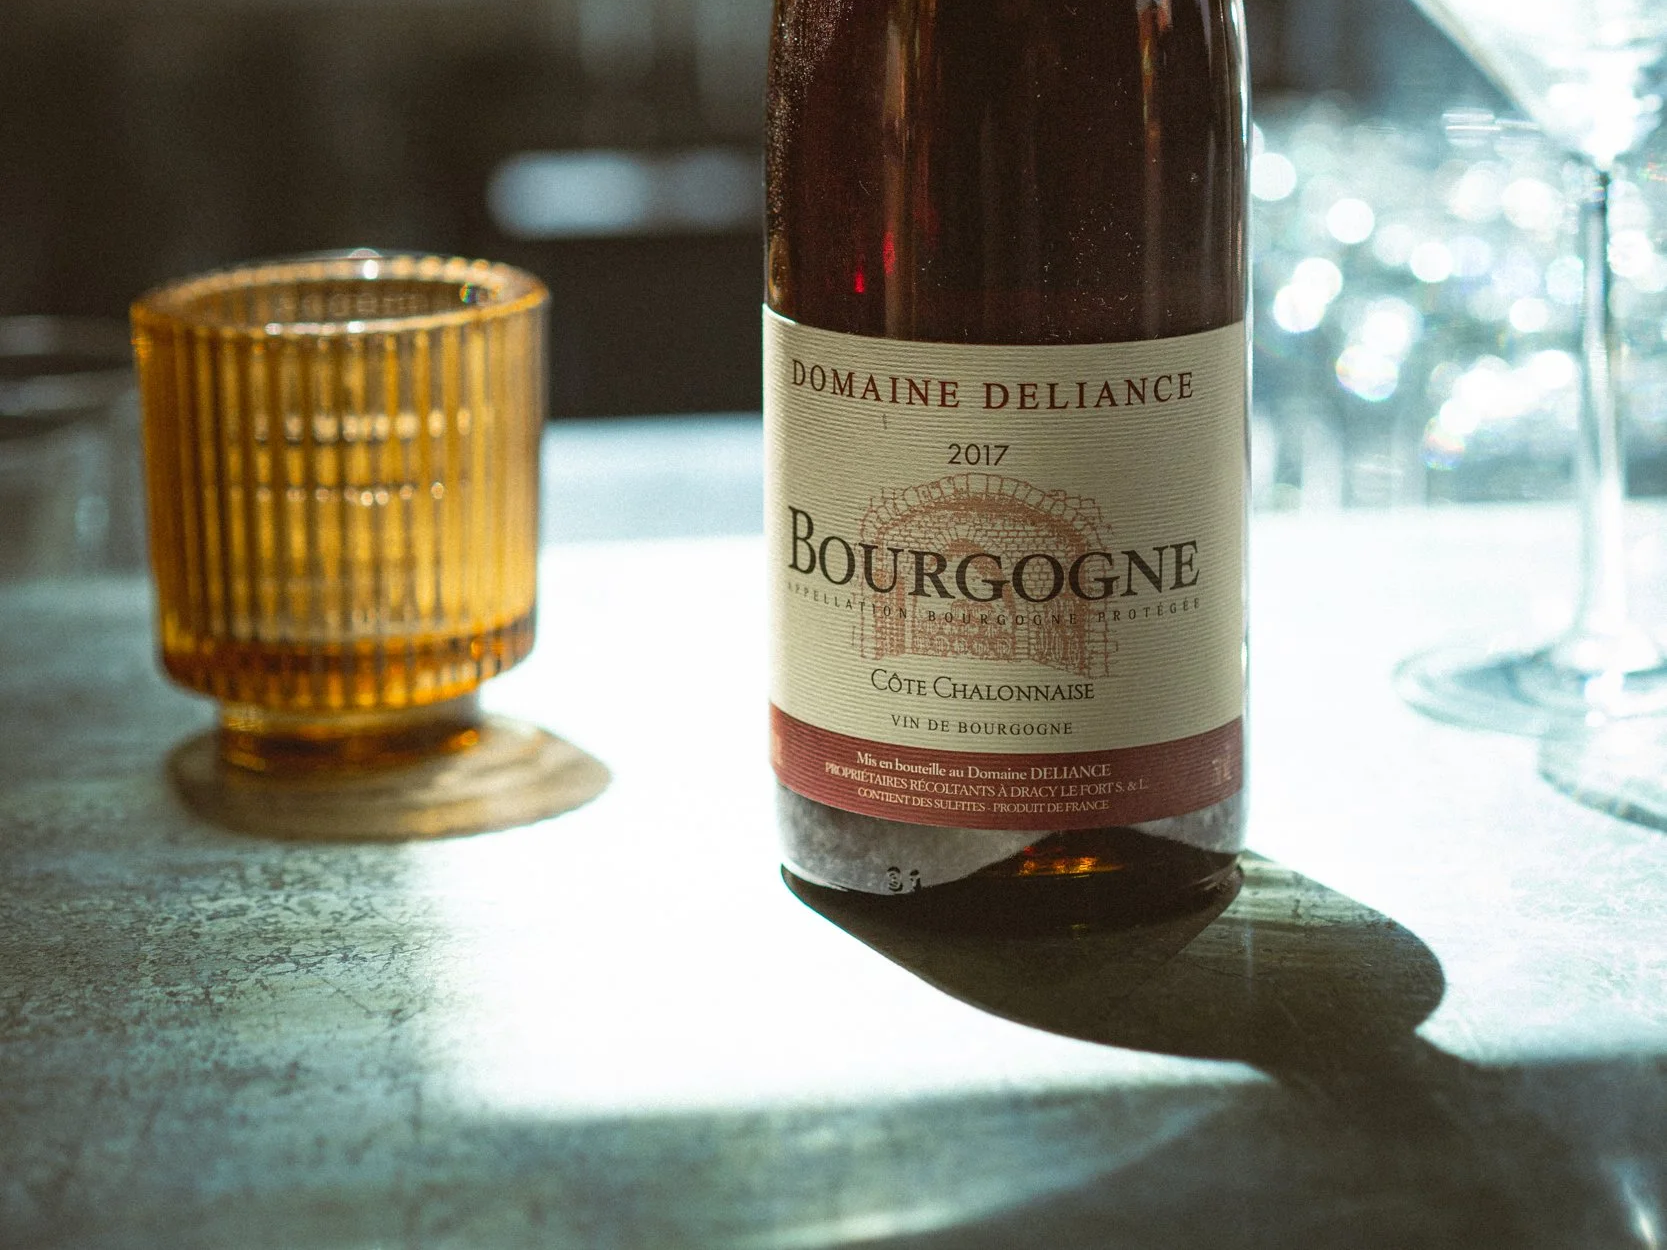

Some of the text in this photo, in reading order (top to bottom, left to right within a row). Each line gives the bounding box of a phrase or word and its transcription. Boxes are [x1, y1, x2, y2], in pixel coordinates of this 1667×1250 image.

[791, 358, 1195, 410] DOMAINE DELIANCE
[947, 443, 1010, 466] 2017
[787, 505, 1200, 603] BOURGOGNE
[788, 582, 1200, 626] APPELLATION BOURGOGNE PROTÉGÉE
[891, 714, 1073, 736] VIN DE BOURGOGNE
[825, 761, 908, 790] PROPRIÉTAIRES
[910, 778, 996, 797] RÉCOLTANTS
[999, 783, 1008, 798] À
[1010, 785, 1058, 798] DRACY
[1060, 784, 1078, 797] LE
[1080, 781, 1115, 796] FORT
[1127, 781, 1137, 792] &
[856, 751, 1112, 781] Mis en bouteille au Domaine DELIANCE
[857, 786, 911, 806] CONTIENT
[912, 796, 933, 808] DES
[935, 799, 985, 812] SULFITES
[993, 802, 1047, 814] PRODUIT
[1047, 802, 1064, 813] DE
[1065, 800, 1110, 812] FRANCE
